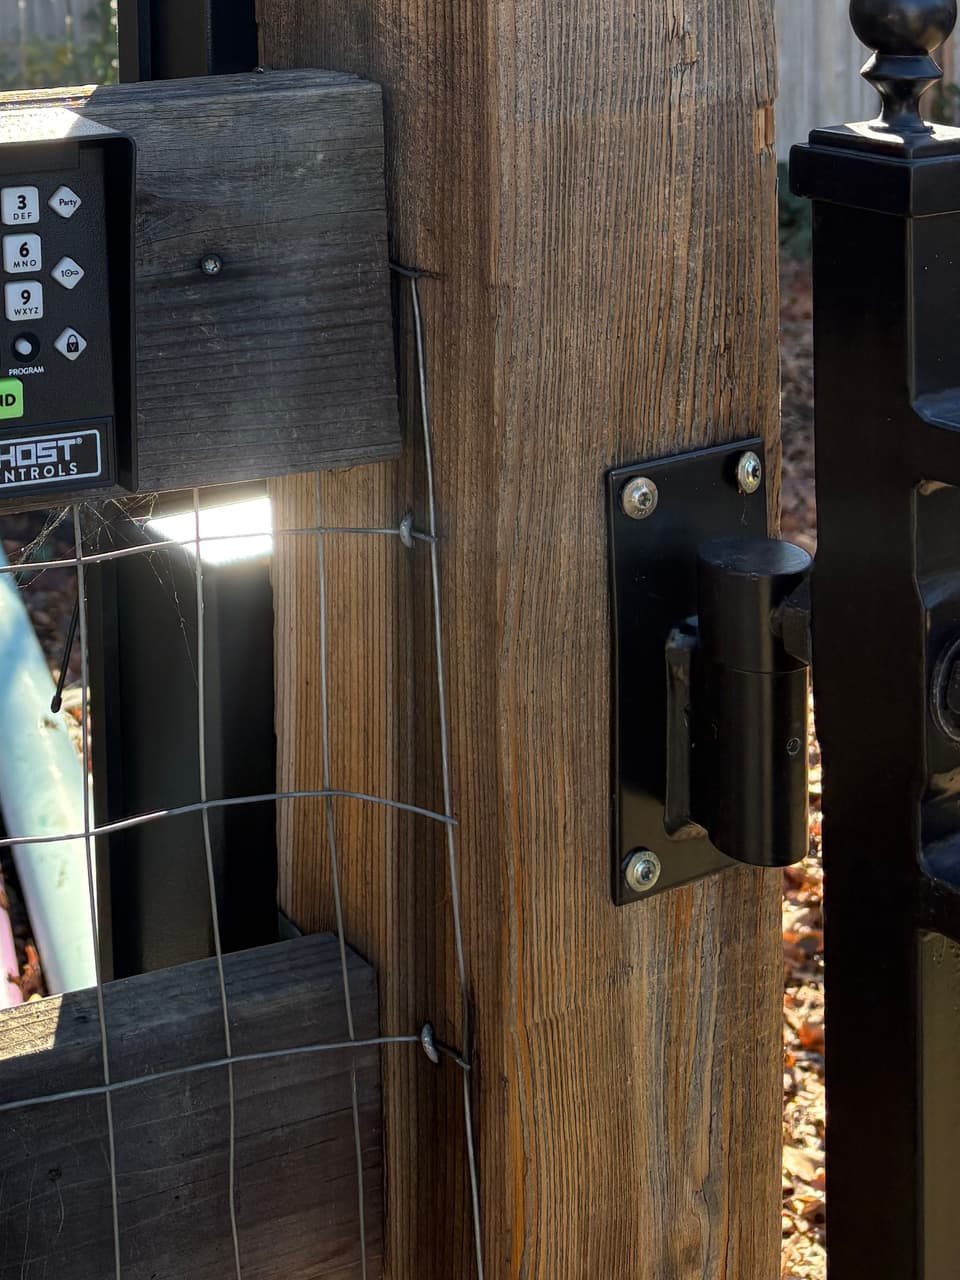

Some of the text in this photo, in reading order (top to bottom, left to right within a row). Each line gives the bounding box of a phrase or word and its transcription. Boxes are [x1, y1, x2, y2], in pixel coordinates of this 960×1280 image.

[17, 195, 27, 210] 3
[59, 199, 77, 207] Party
[14, 212, 32, 220] DEF
[19, 242, 29, 257] 6
[14, 260, 36, 268] MNO
[21, 290, 31, 305] 9
[14, 307, 38, 316] WXYZ
[9, 366, 44, 376] PROGRAM
